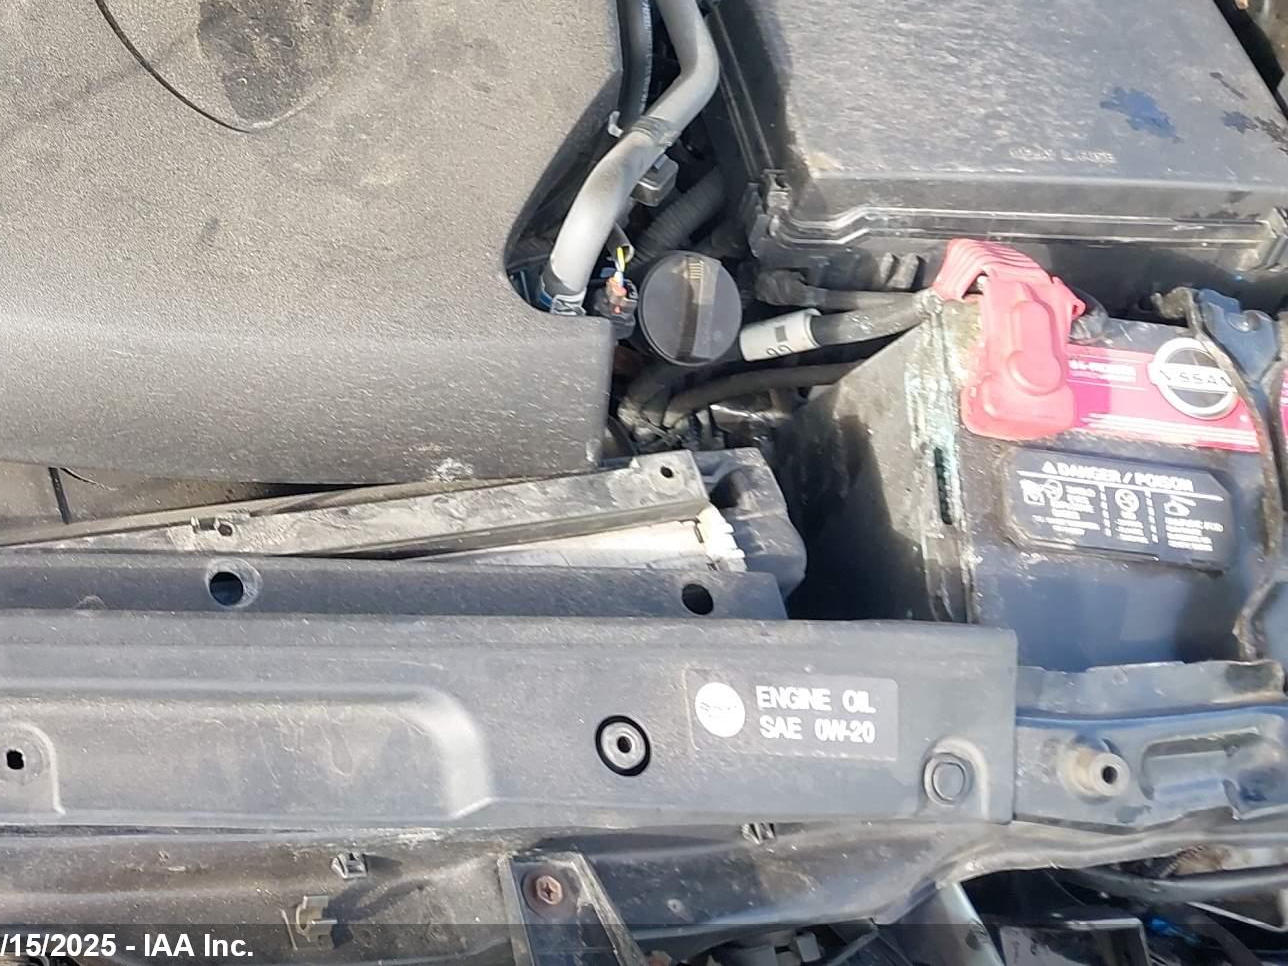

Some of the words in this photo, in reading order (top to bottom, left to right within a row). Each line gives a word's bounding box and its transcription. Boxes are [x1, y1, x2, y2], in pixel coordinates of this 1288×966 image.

[1056, 462, 1122, 483] DANGER
[755, 684, 832, 712] ENGINE
[841, 689, 877, 714] OIL
[759, 715, 803, 740] SAE
[814, 719, 876, 744] 0W-20
